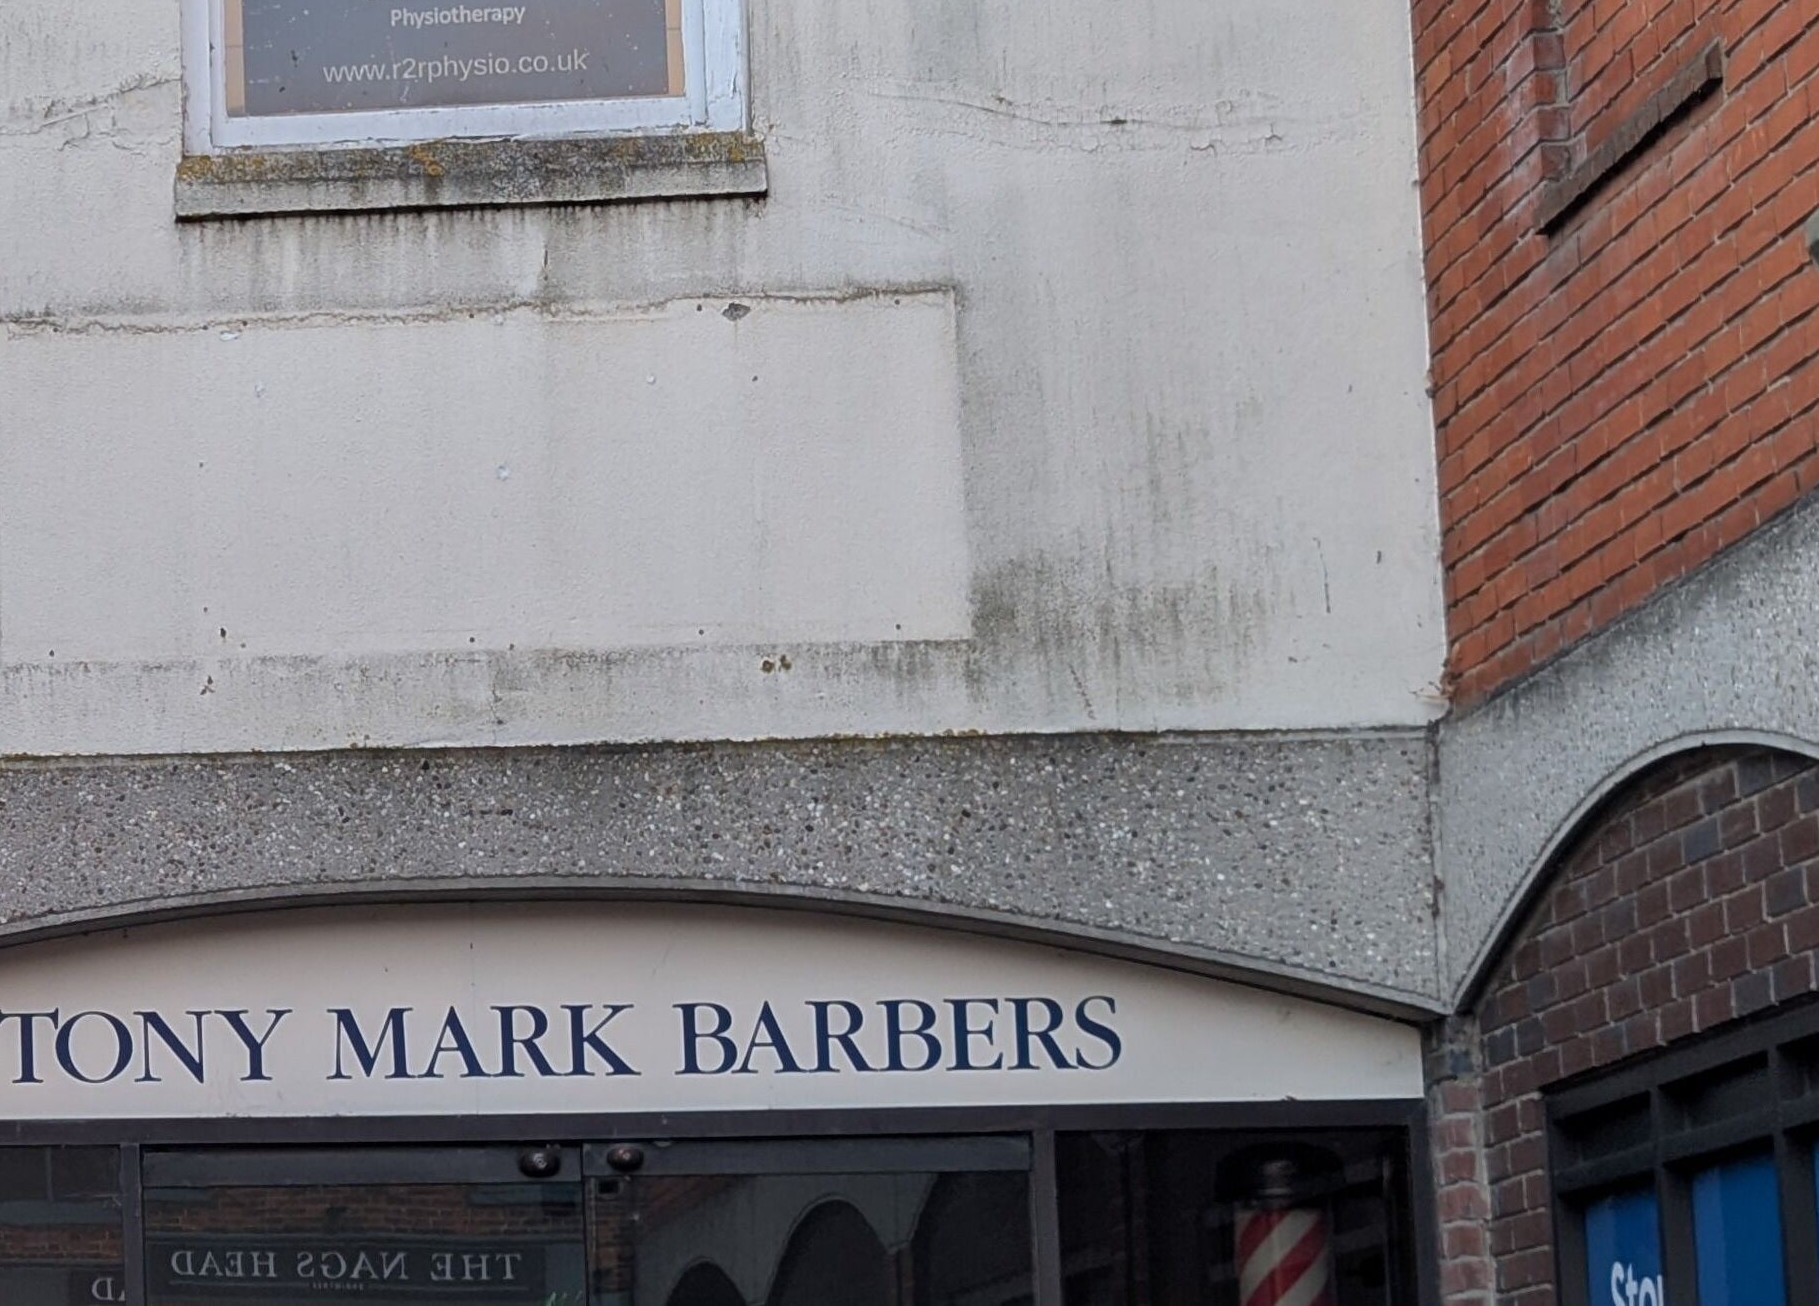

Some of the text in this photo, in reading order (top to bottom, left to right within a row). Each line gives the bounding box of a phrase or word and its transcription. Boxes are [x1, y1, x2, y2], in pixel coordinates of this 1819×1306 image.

[390, 5, 526, 29] Physiotherapy
[323, 49, 591, 83] www.r2rphysio.co.uk
[326, 1004, 642, 1080] MARK
[673, 995, 1123, 1074] BARBERS
